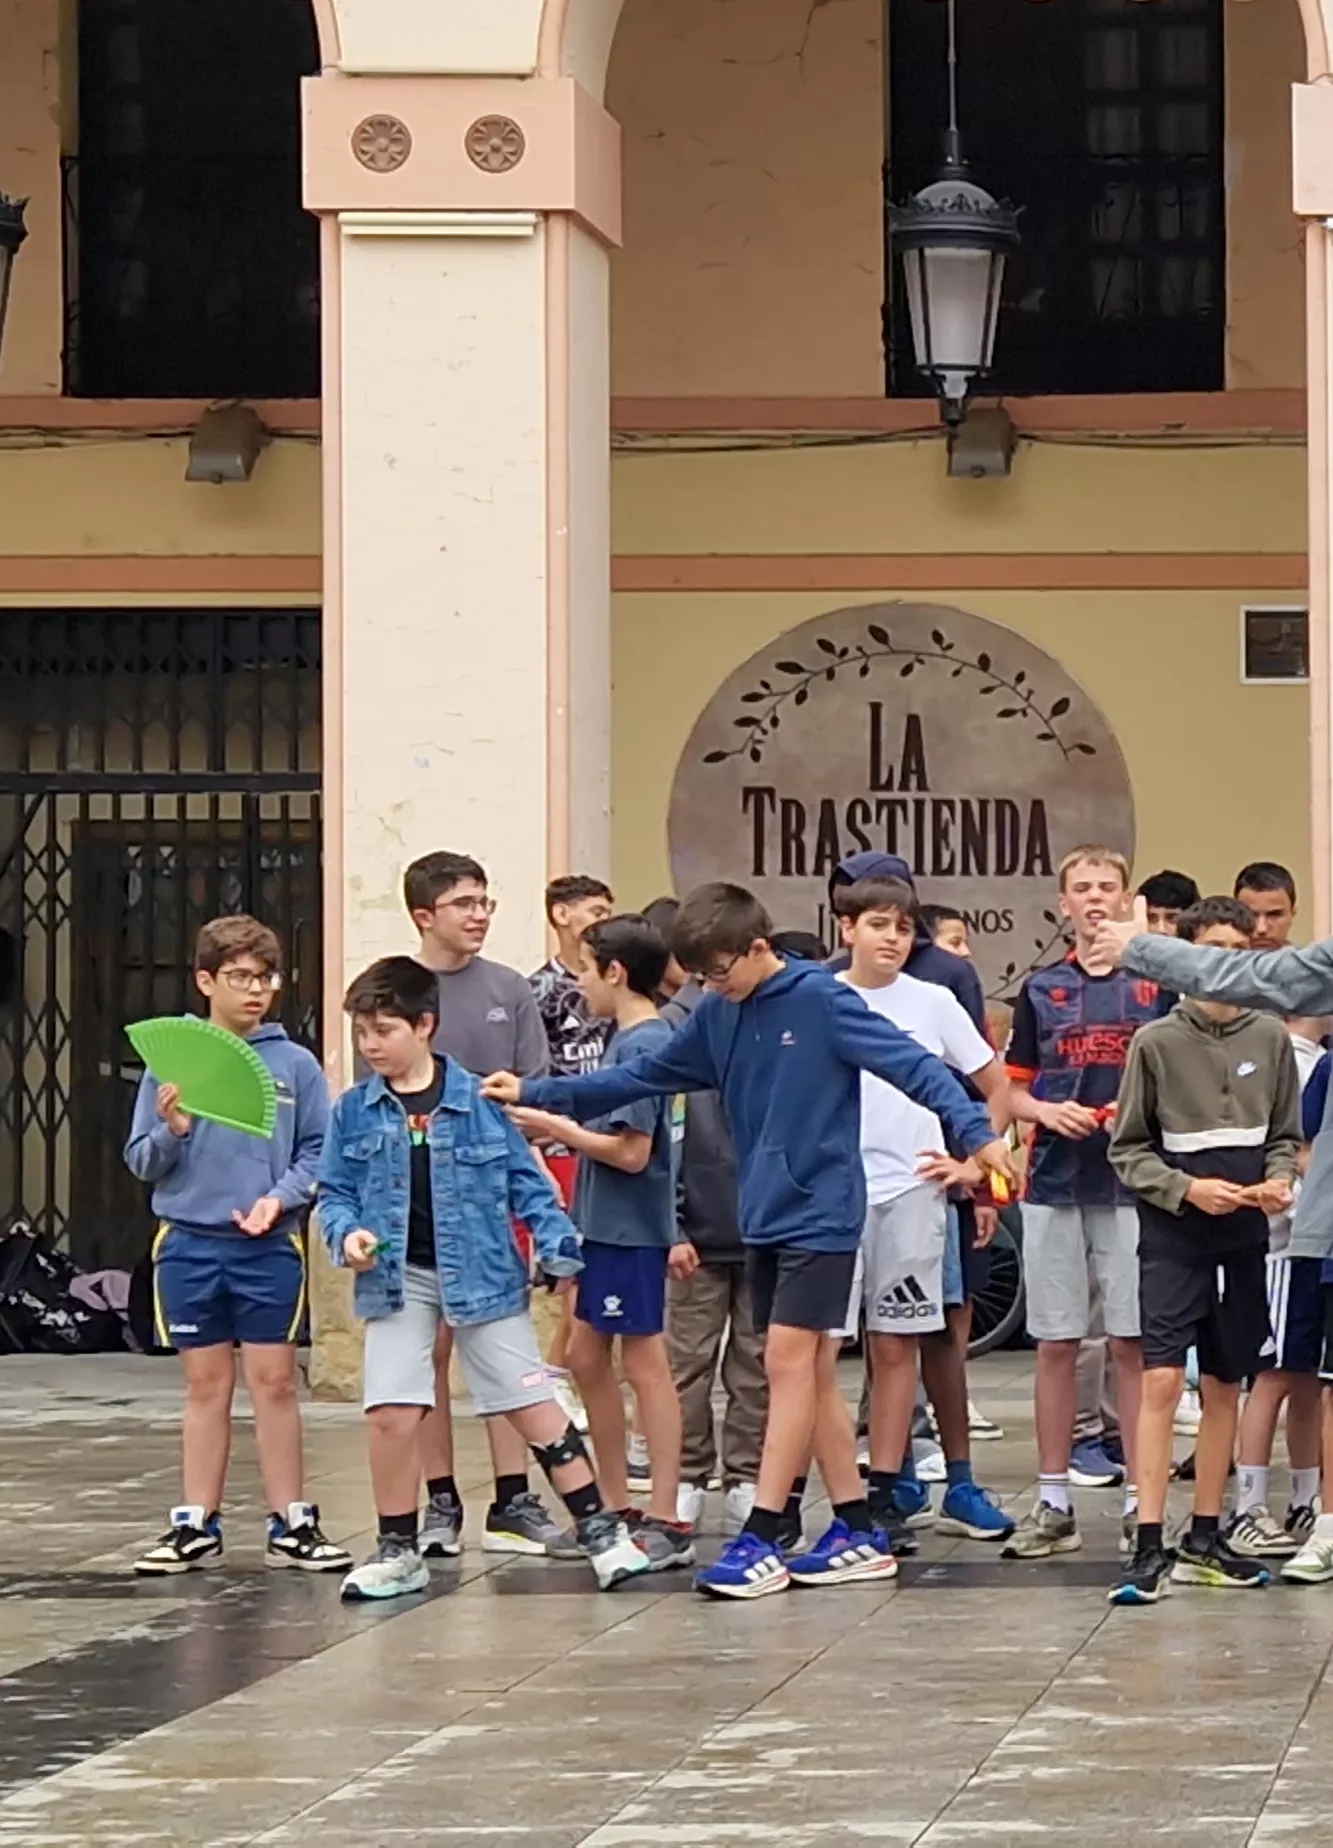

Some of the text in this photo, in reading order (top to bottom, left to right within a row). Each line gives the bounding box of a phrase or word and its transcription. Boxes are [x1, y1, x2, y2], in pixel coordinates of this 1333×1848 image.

[868, 701, 929, 792] LA
[742, 786, 1055, 877] TRASTIENDA
[1057, 1031, 1131, 1056] HUESC
